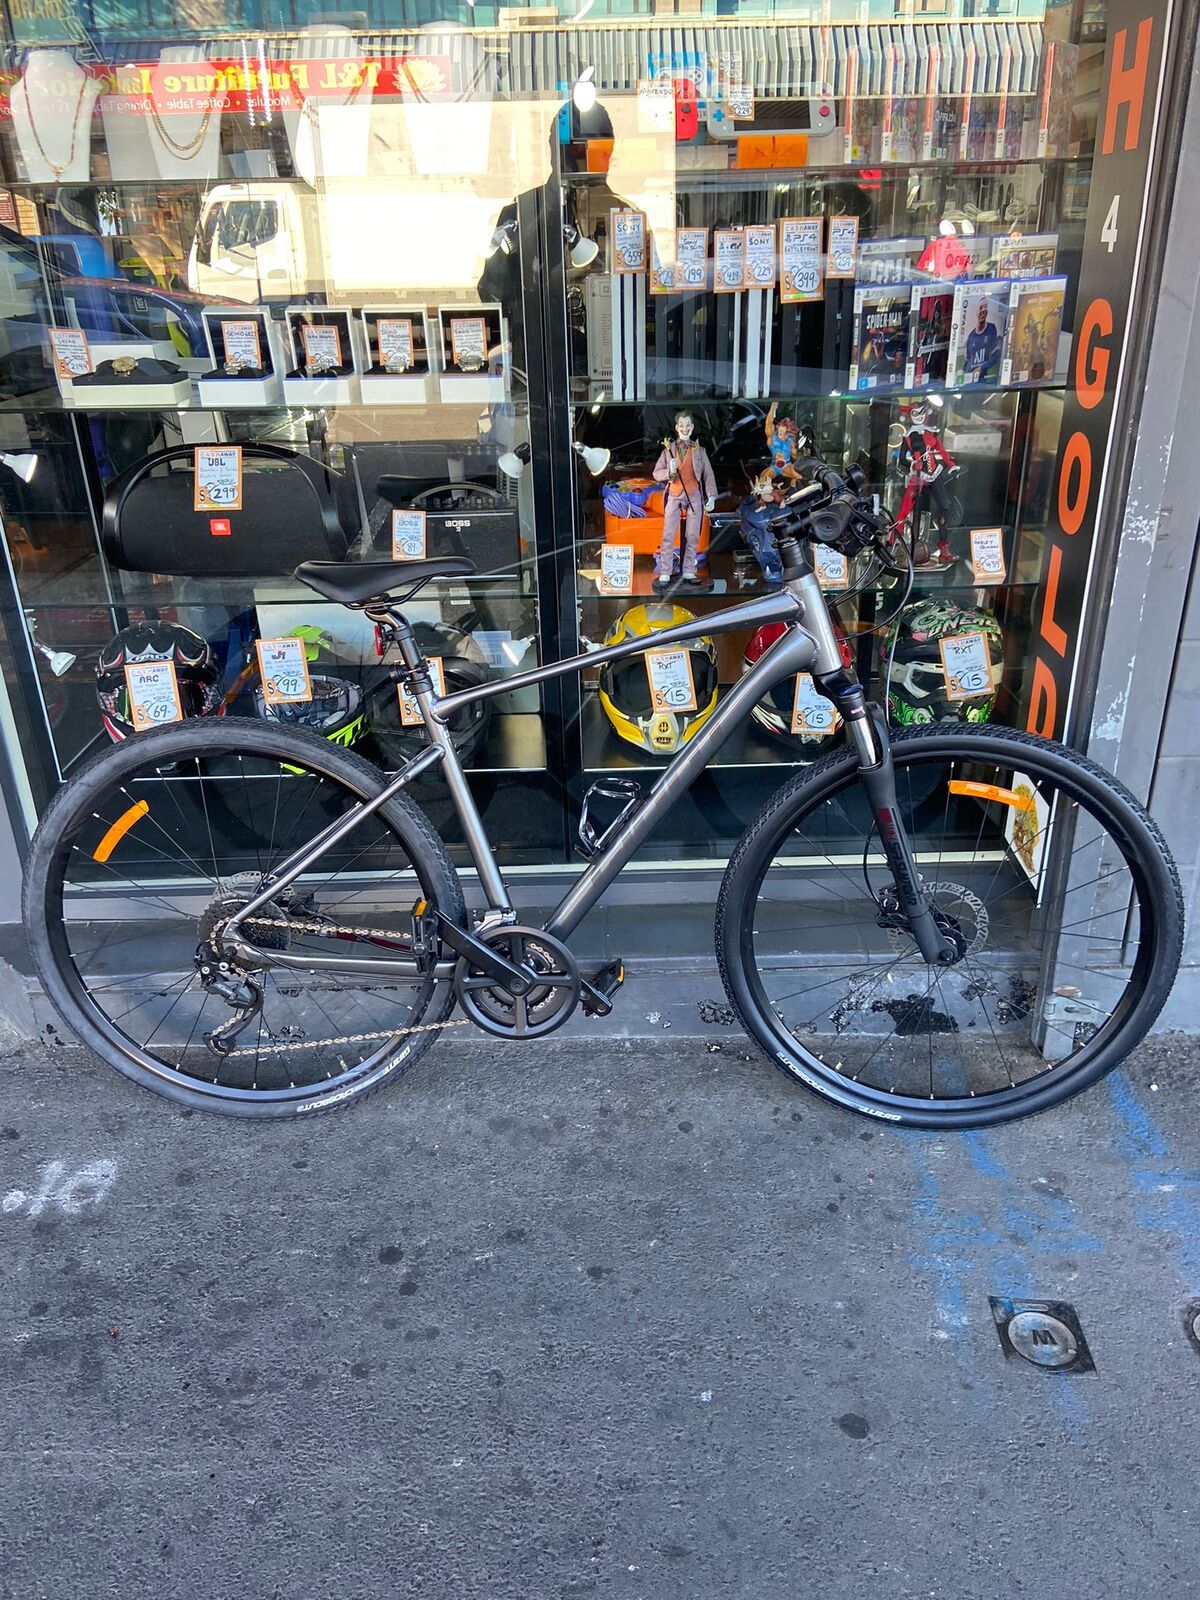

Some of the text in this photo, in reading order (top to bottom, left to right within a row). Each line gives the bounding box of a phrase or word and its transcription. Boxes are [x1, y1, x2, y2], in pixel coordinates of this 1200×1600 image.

[617, 223, 641, 233] SONY
[1100, 194, 1120, 253] 4
[748, 237, 770, 246] SONY
[213, 487, 236, 499] 299
[444, 519, 471, 528] BOSS
[966, 674, 983, 688] 15
[670, 689, 686, 702] 15
[811, 713, 824, 724] 15
